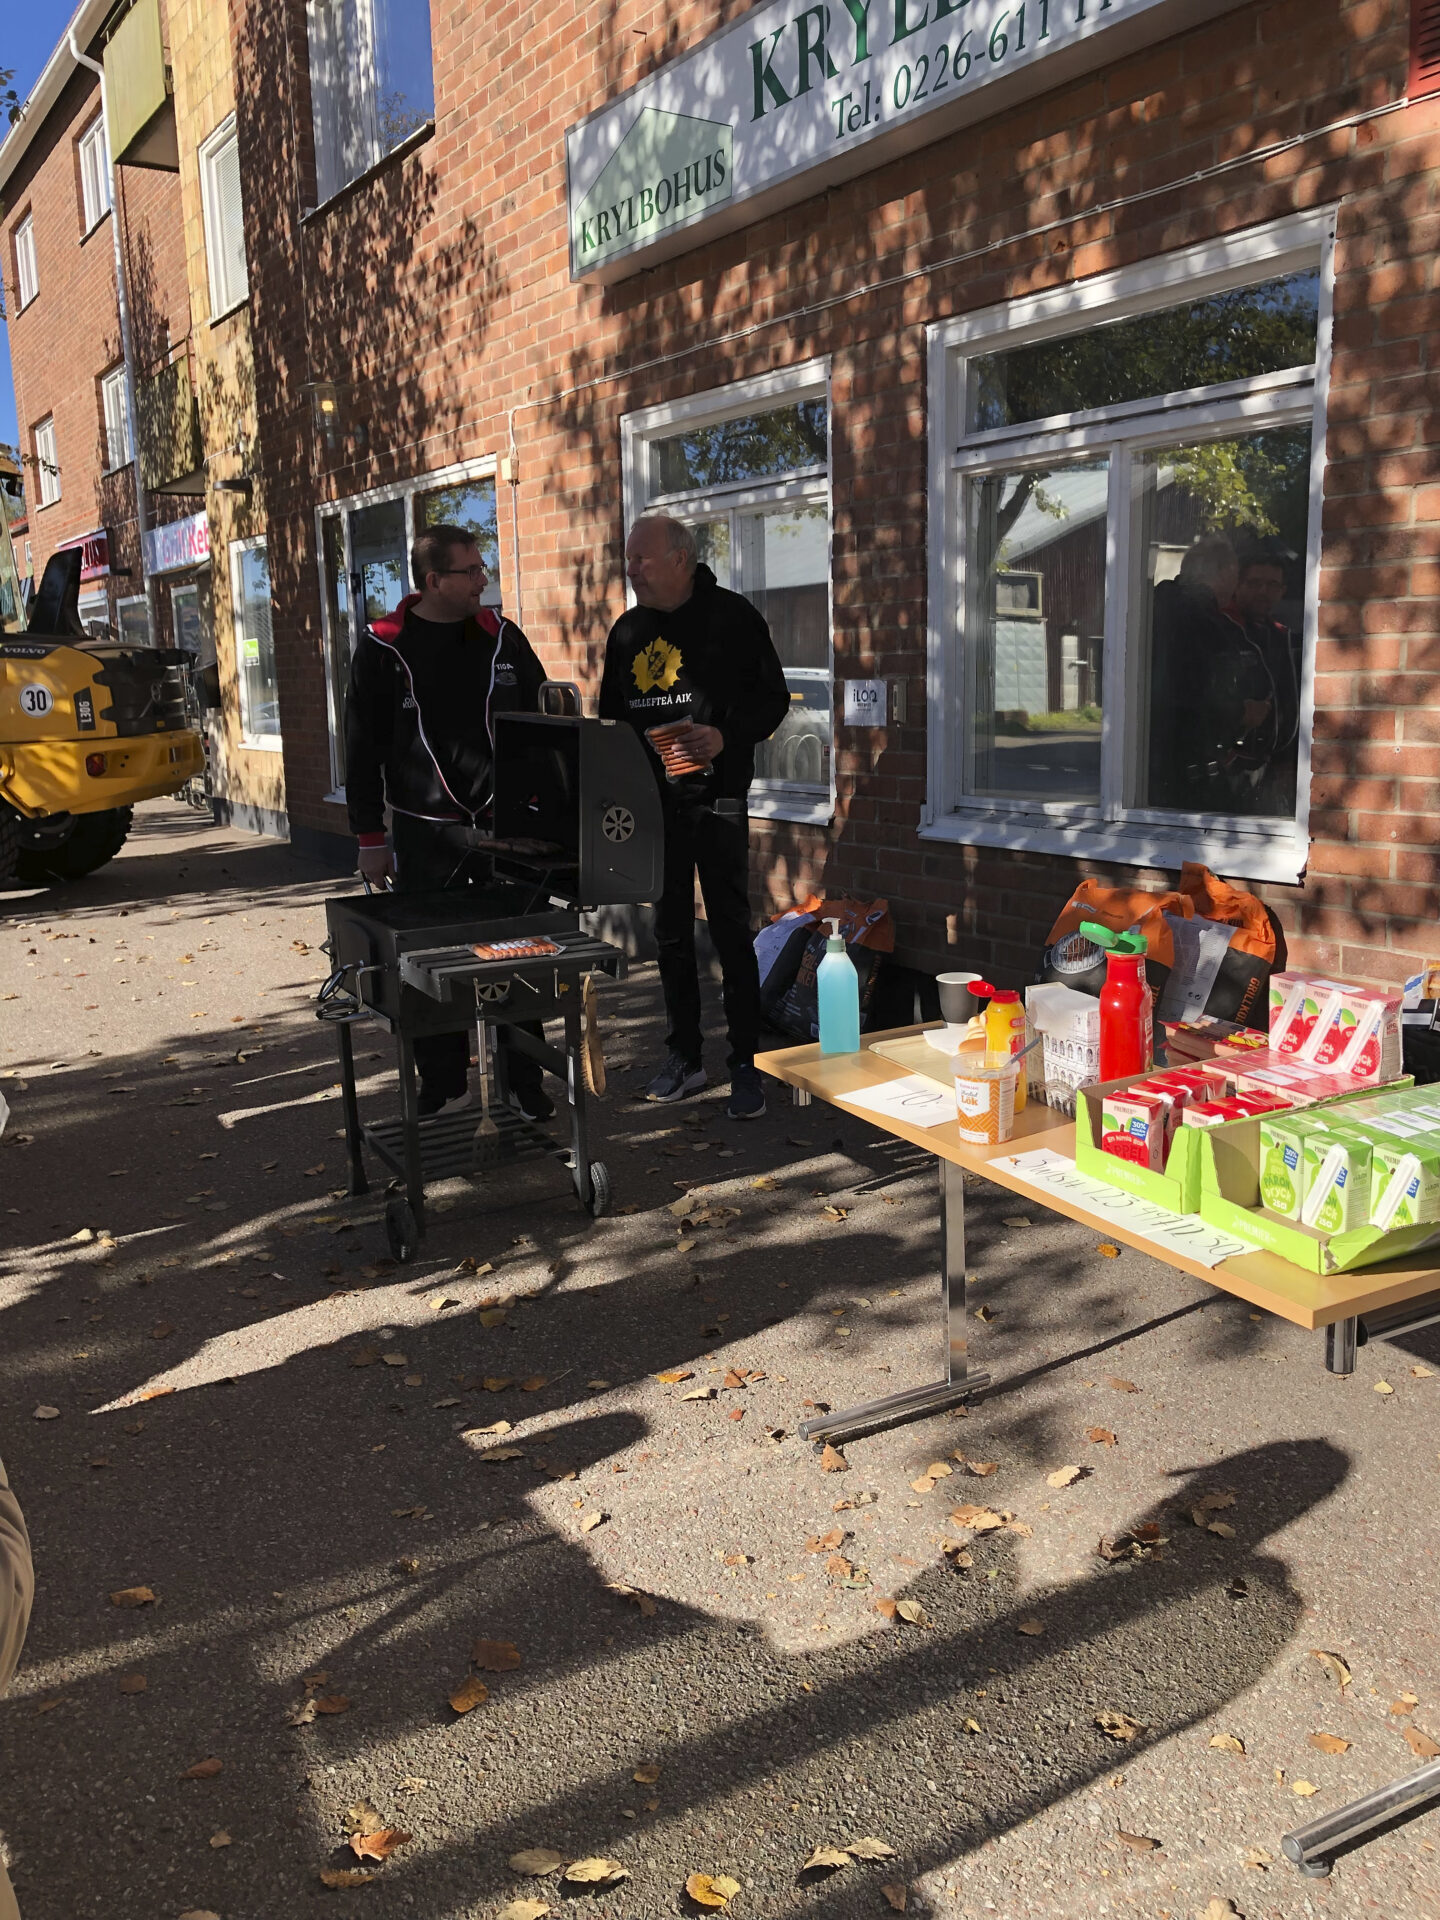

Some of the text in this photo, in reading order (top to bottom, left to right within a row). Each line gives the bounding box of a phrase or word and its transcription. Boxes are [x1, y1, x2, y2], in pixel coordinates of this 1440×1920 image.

[750, 0, 971, 123] KRYL
[831, 0, 1050, 140] Tel: 0226-611
[581, 148, 726, 254] KRYLBOHUS
[3, 647, 46, 655] VOLVO
[25, 689, 47, 712] 30
[675, 692, 693, 704] AIK
[961, 1095, 978, 1106] Lök
[1132, 1121, 1146, 1131] 30%
